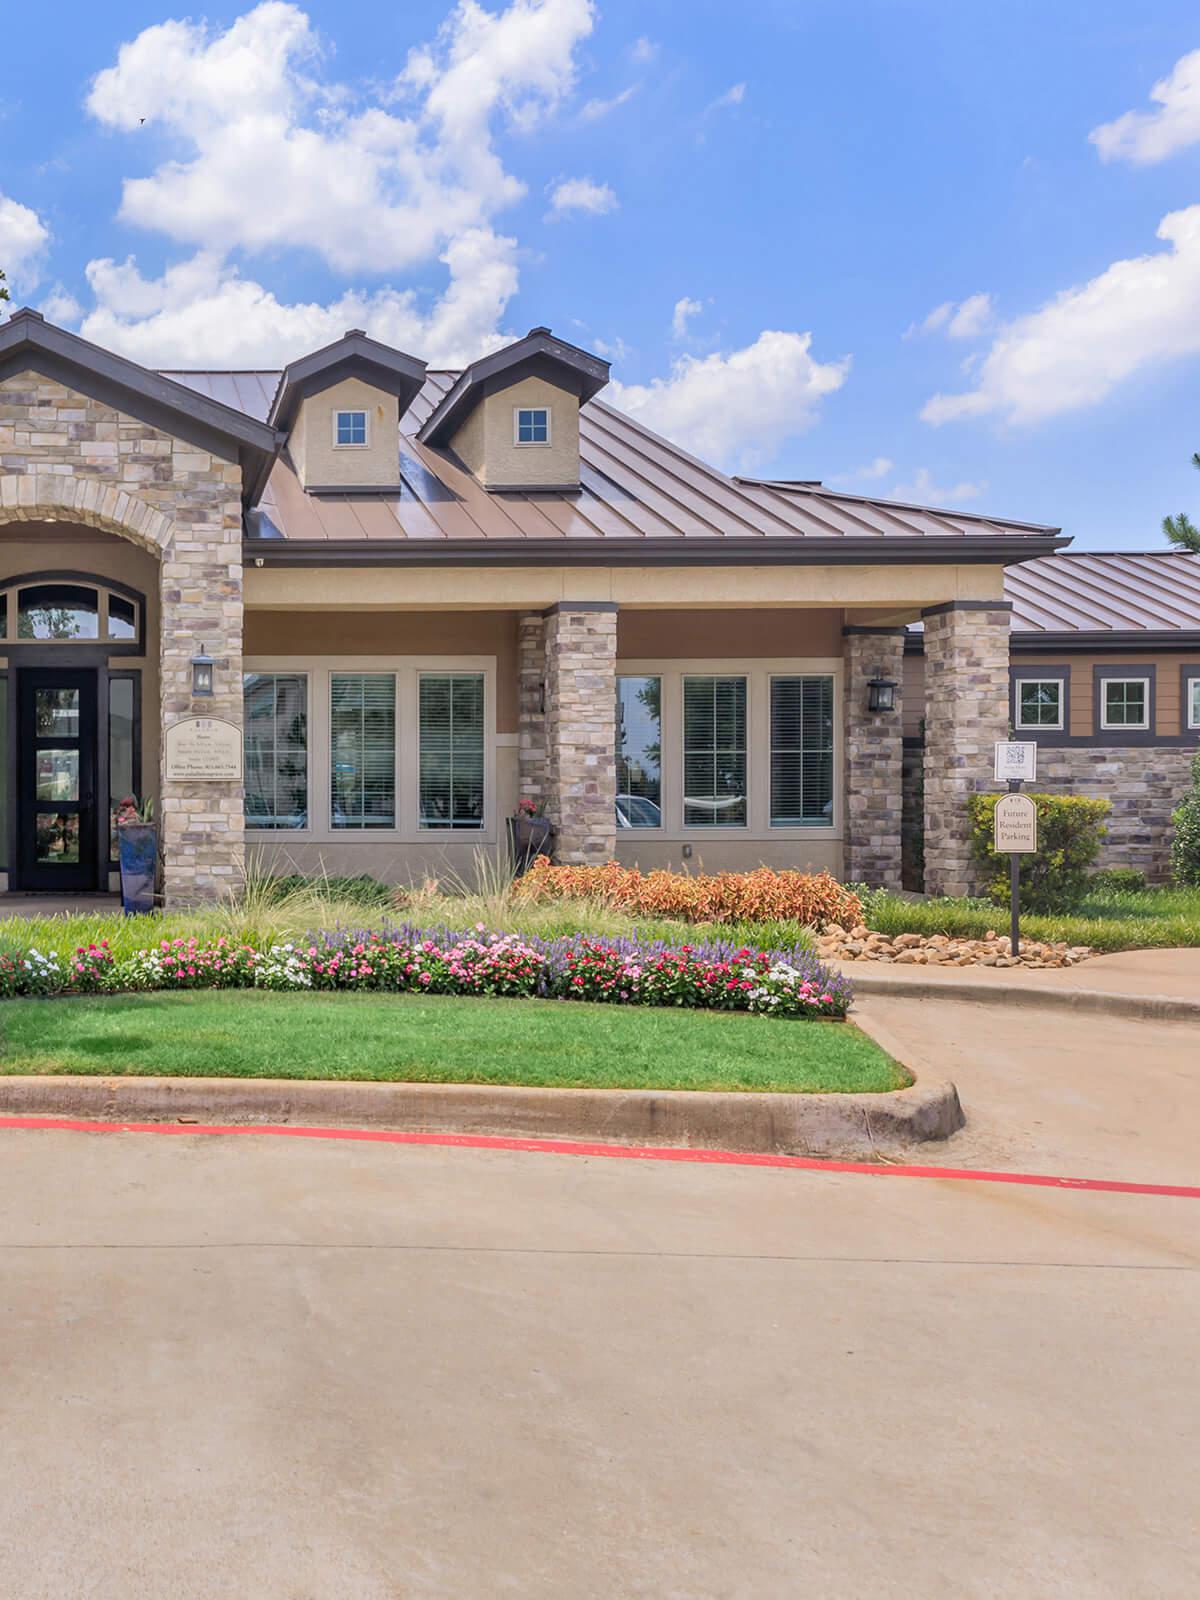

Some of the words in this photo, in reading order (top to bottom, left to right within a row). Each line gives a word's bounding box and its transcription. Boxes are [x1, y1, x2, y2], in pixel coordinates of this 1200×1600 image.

[1003, 809, 1028, 817] Future
[999, 821, 1032, 829] Resident
[1001, 832, 1030, 841] Parking
